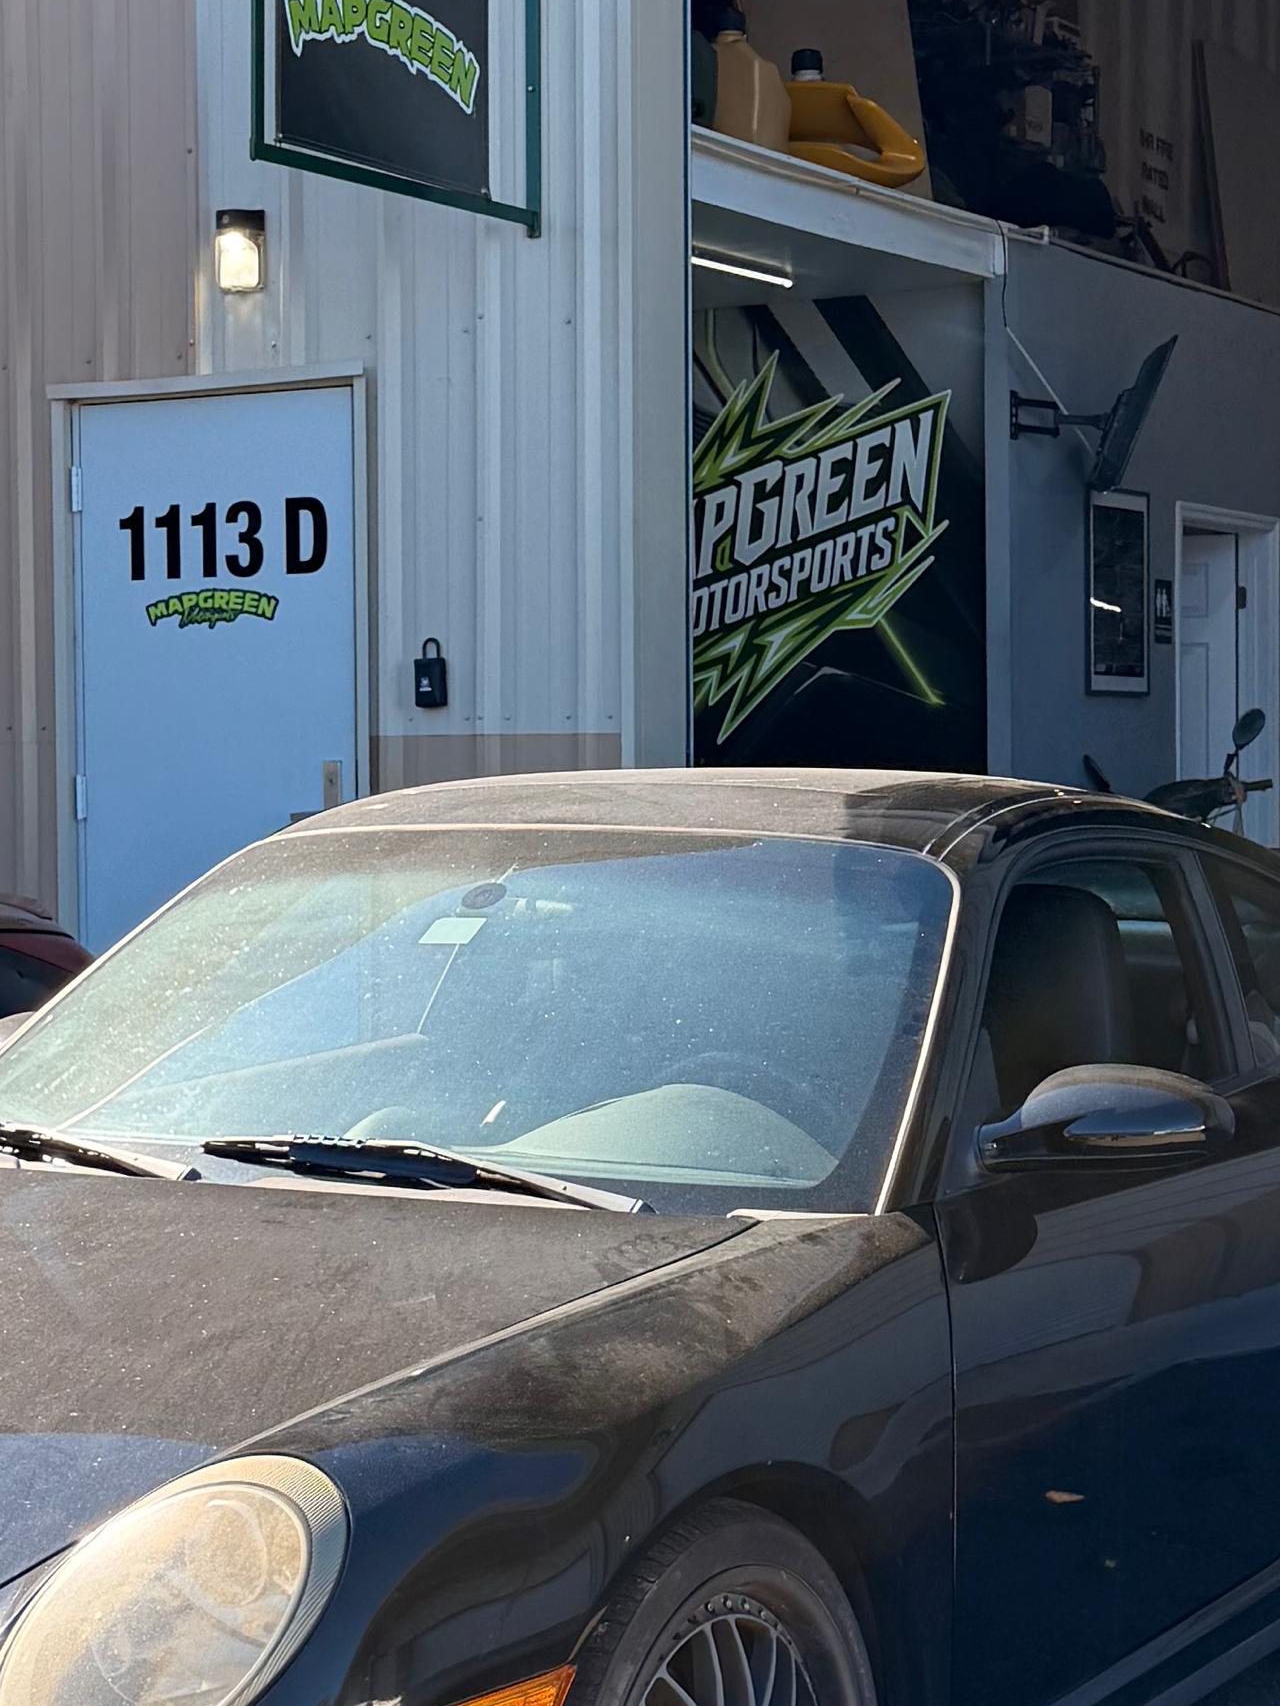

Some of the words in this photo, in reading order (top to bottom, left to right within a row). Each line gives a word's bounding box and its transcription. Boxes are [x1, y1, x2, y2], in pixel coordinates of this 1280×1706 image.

[1141, 161, 1169, 191] RATED
[1142, 195, 1166, 223] WALL
[693, 410, 934, 580] PGREEN
[120, 501, 264, 580] 1113
[285, 497, 328, 574] D
[146, 589, 279, 626] MAPGREEN
